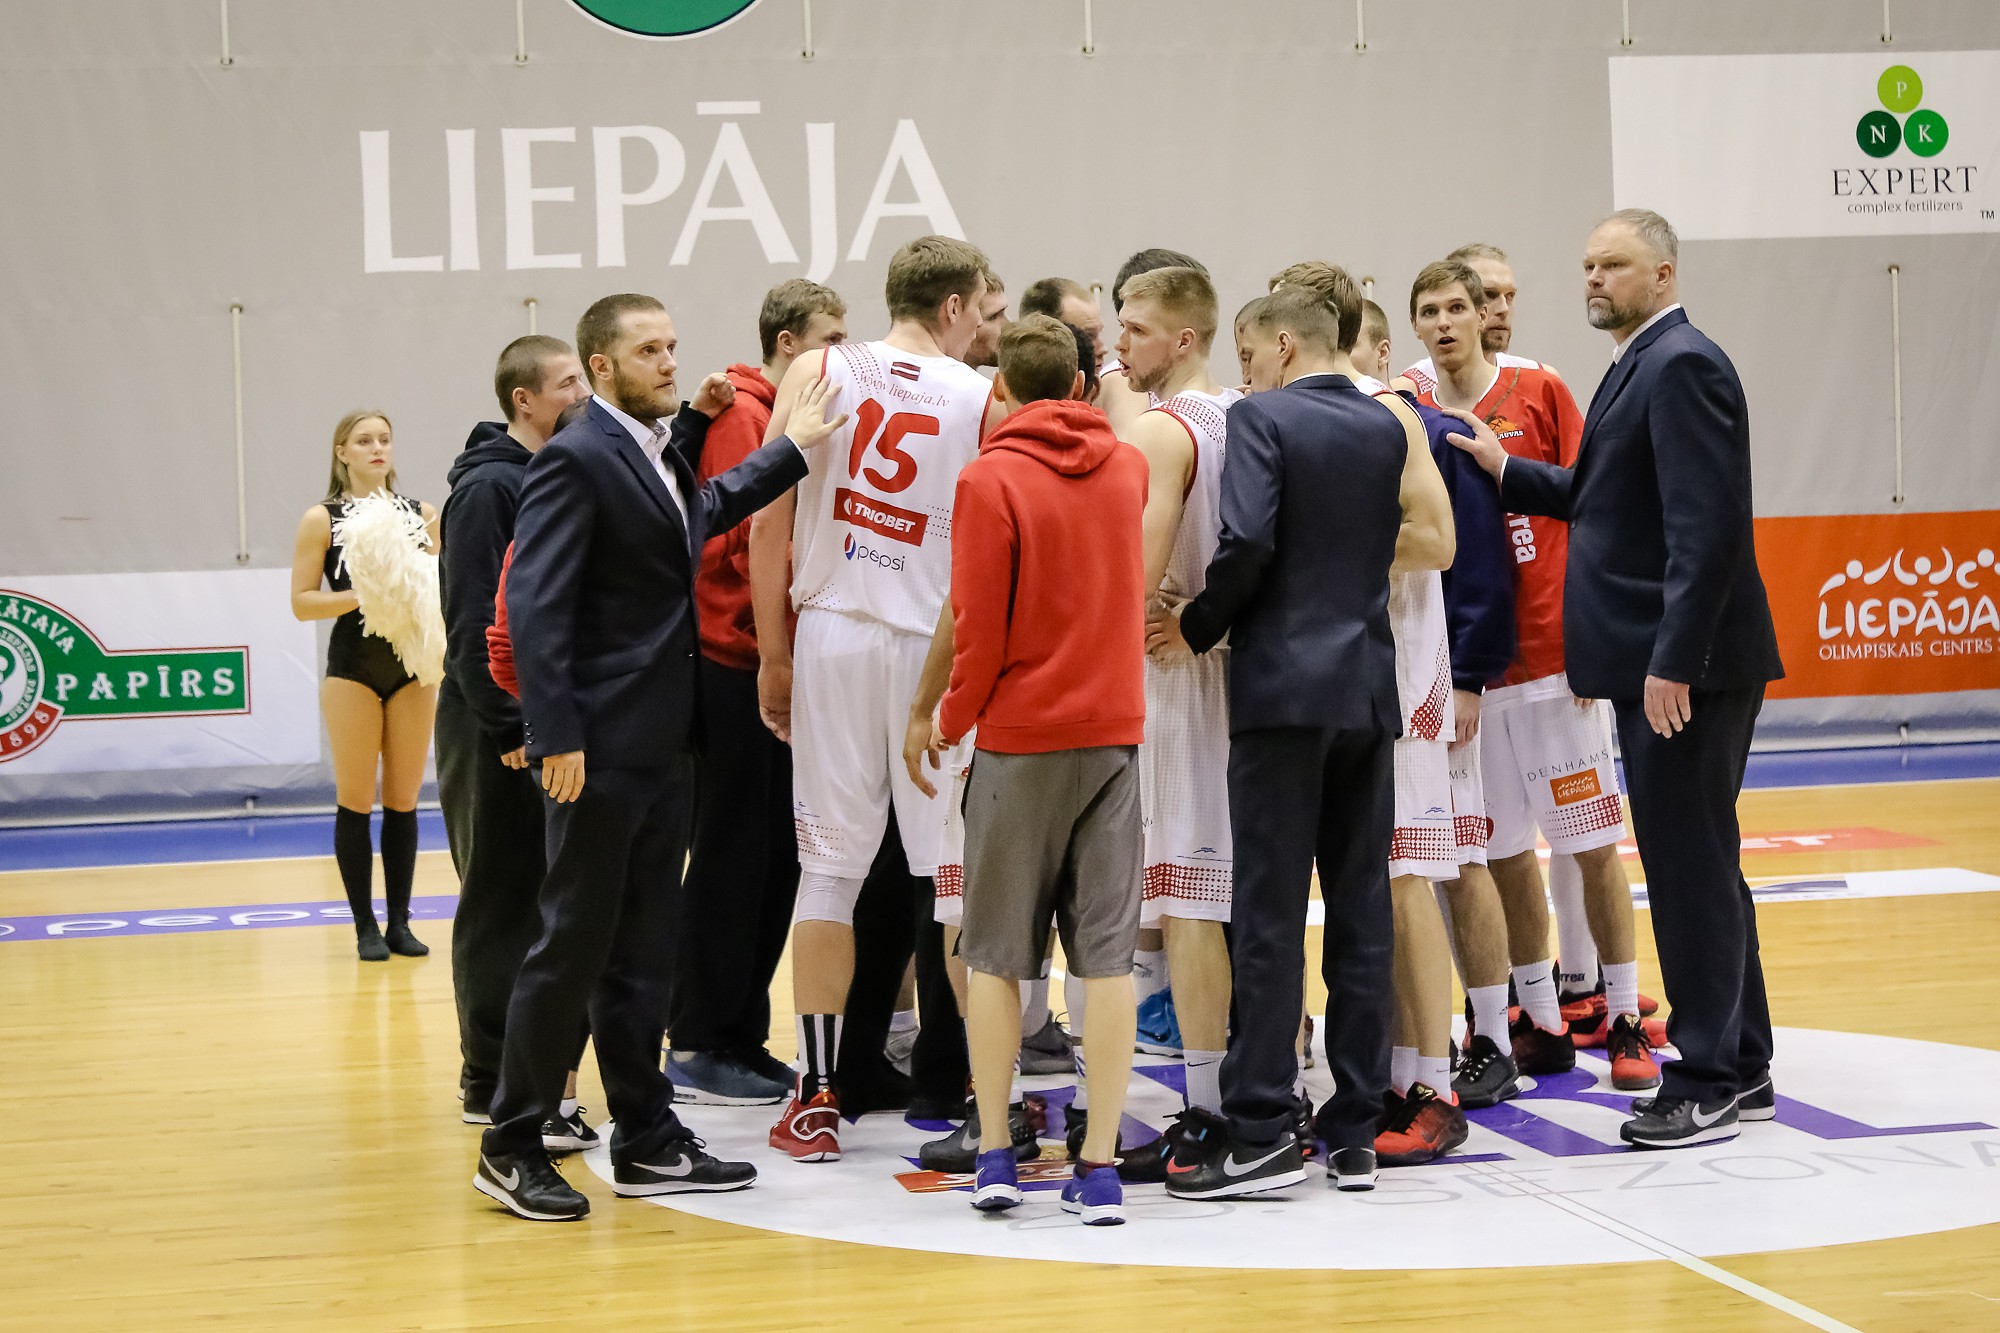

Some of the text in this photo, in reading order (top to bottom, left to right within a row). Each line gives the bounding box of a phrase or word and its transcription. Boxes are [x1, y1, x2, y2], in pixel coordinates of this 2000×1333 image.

[1896, 81, 1907, 98] P
[1870, 124, 1933, 144] N K
[359, 101, 968, 284] LIEPĀJA
[1832, 166, 1977, 196] EXPERT
[1848, 200, 1963, 215] complex fertilizers
[849, 398, 940, 493] 15
[855, 502, 916, 533] TRIOBET
[1507, 513, 1537, 564] rea
[857, 545, 906, 572] pepsi
[0, 598, 76, 656] ĀTAVA
[1818, 590, 2000, 640] LIEPĀJA
[1819, 638, 1993, 660] OLIMPISKAIS CENTRS
[55, 665, 235, 701] PAPĪRS
[1527, 751, 1609, 782] DENHAMS
[46, 907, 415, 936] peps
